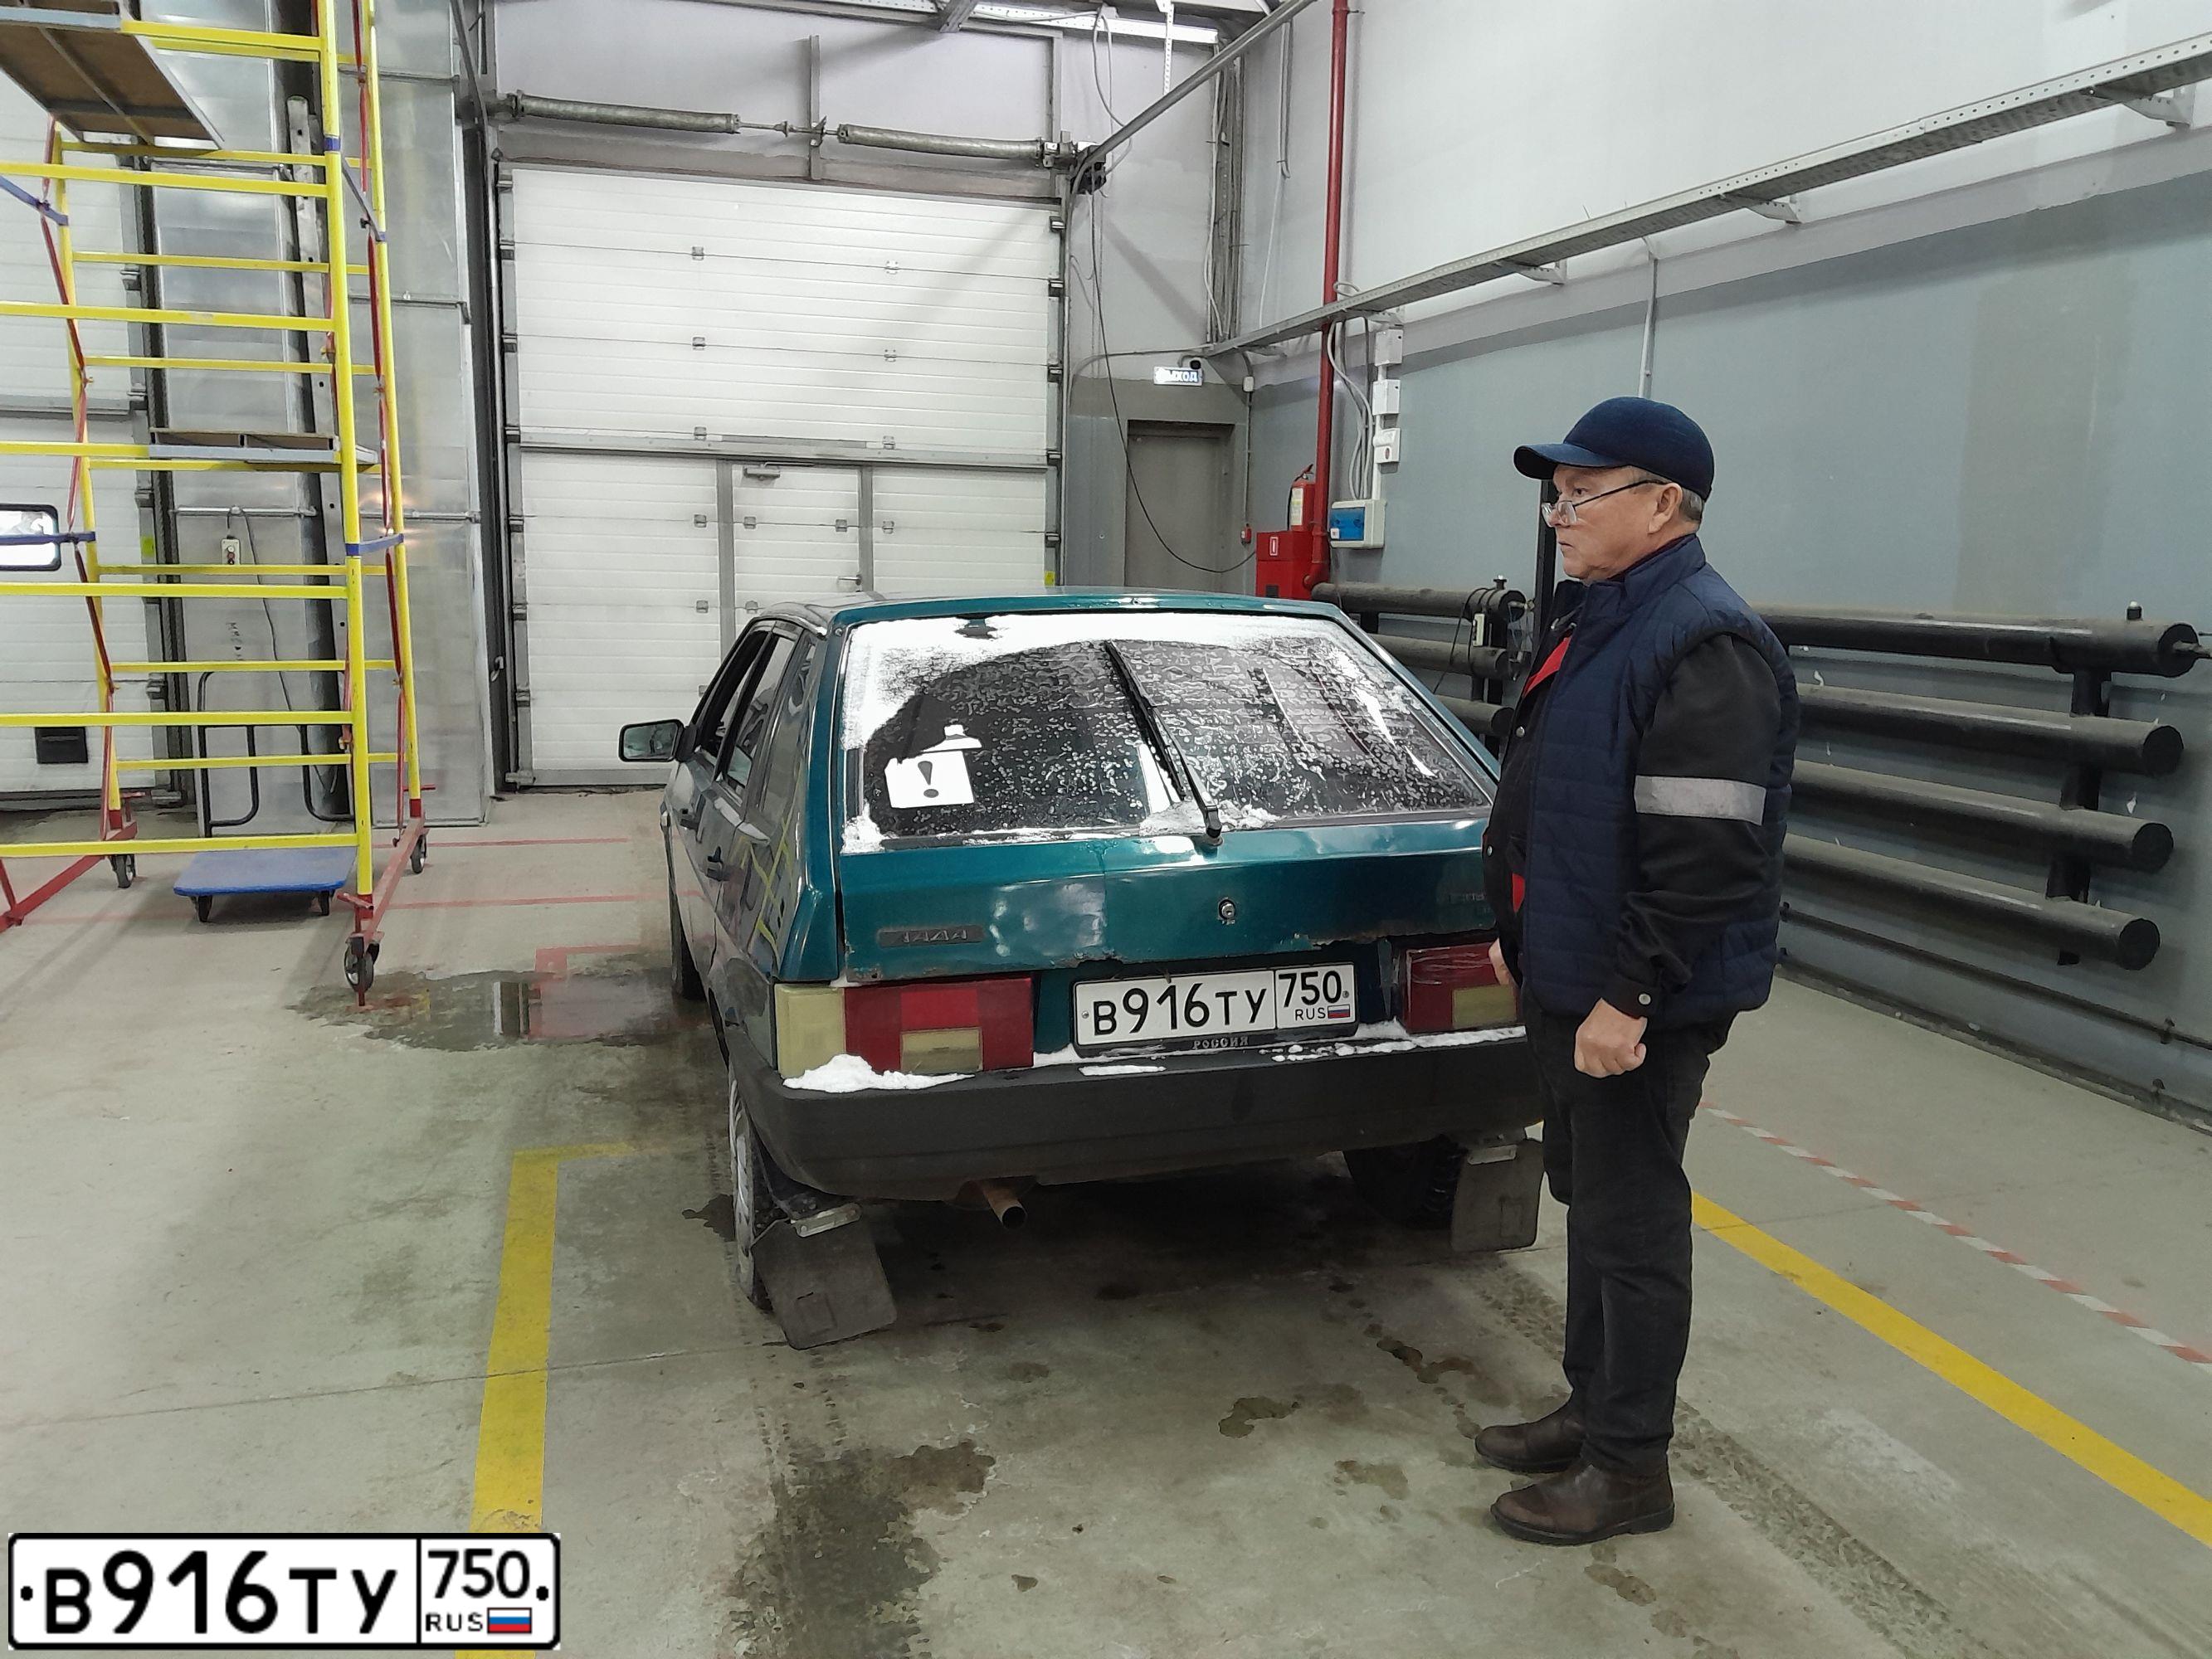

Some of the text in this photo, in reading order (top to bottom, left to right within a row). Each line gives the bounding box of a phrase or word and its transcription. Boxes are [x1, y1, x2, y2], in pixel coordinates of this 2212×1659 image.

[1278, 970, 1342, 1007] 750
[1294, 1006, 1327, 1021] RUS
[1192, 1035, 1249, 1050] РОССИЯ
